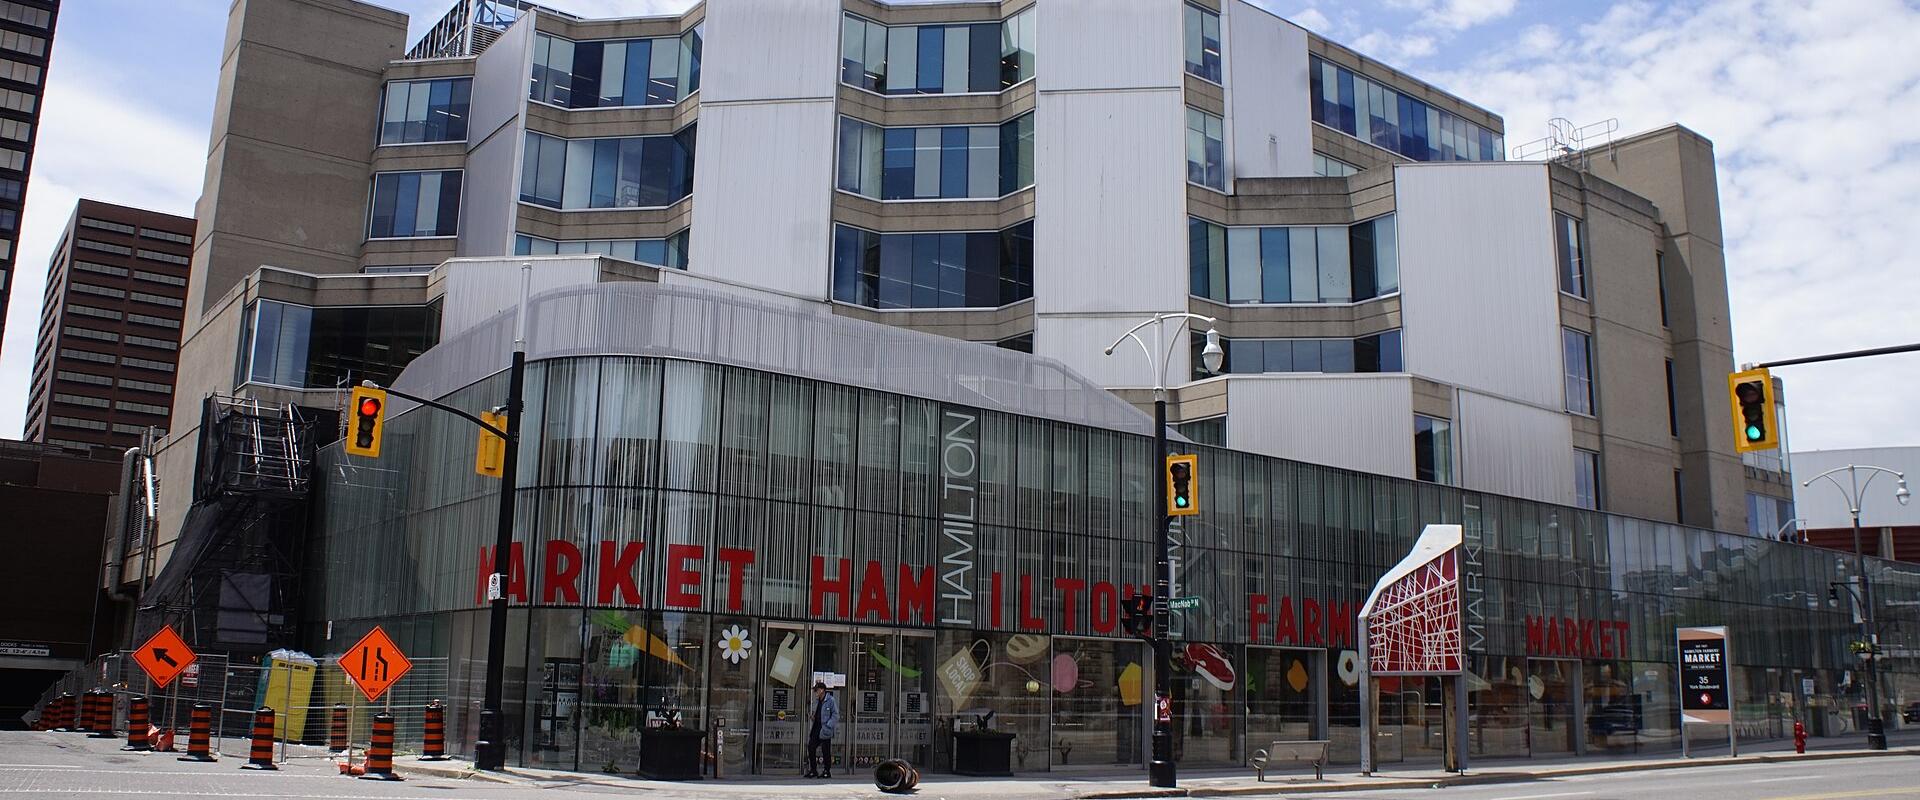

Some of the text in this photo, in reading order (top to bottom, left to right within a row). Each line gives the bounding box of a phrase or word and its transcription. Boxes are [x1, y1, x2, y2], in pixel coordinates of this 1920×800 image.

[941, 411, 976, 625] HAMILTON
[1463, 495, 1486, 652] MARKET
[1169, 600, 1190, 609] MacNab
[1195, 599, 1199, 607] N
[1250, 594, 1363, 647] FARM
[1526, 614, 1630, 658] MARKET
[957, 656, 975, 681] SHOP
[1684, 653, 1720, 663] MARKET
[945, 663, 967, 696] LOCAL
[1698, 676, 1709, 684] 35
